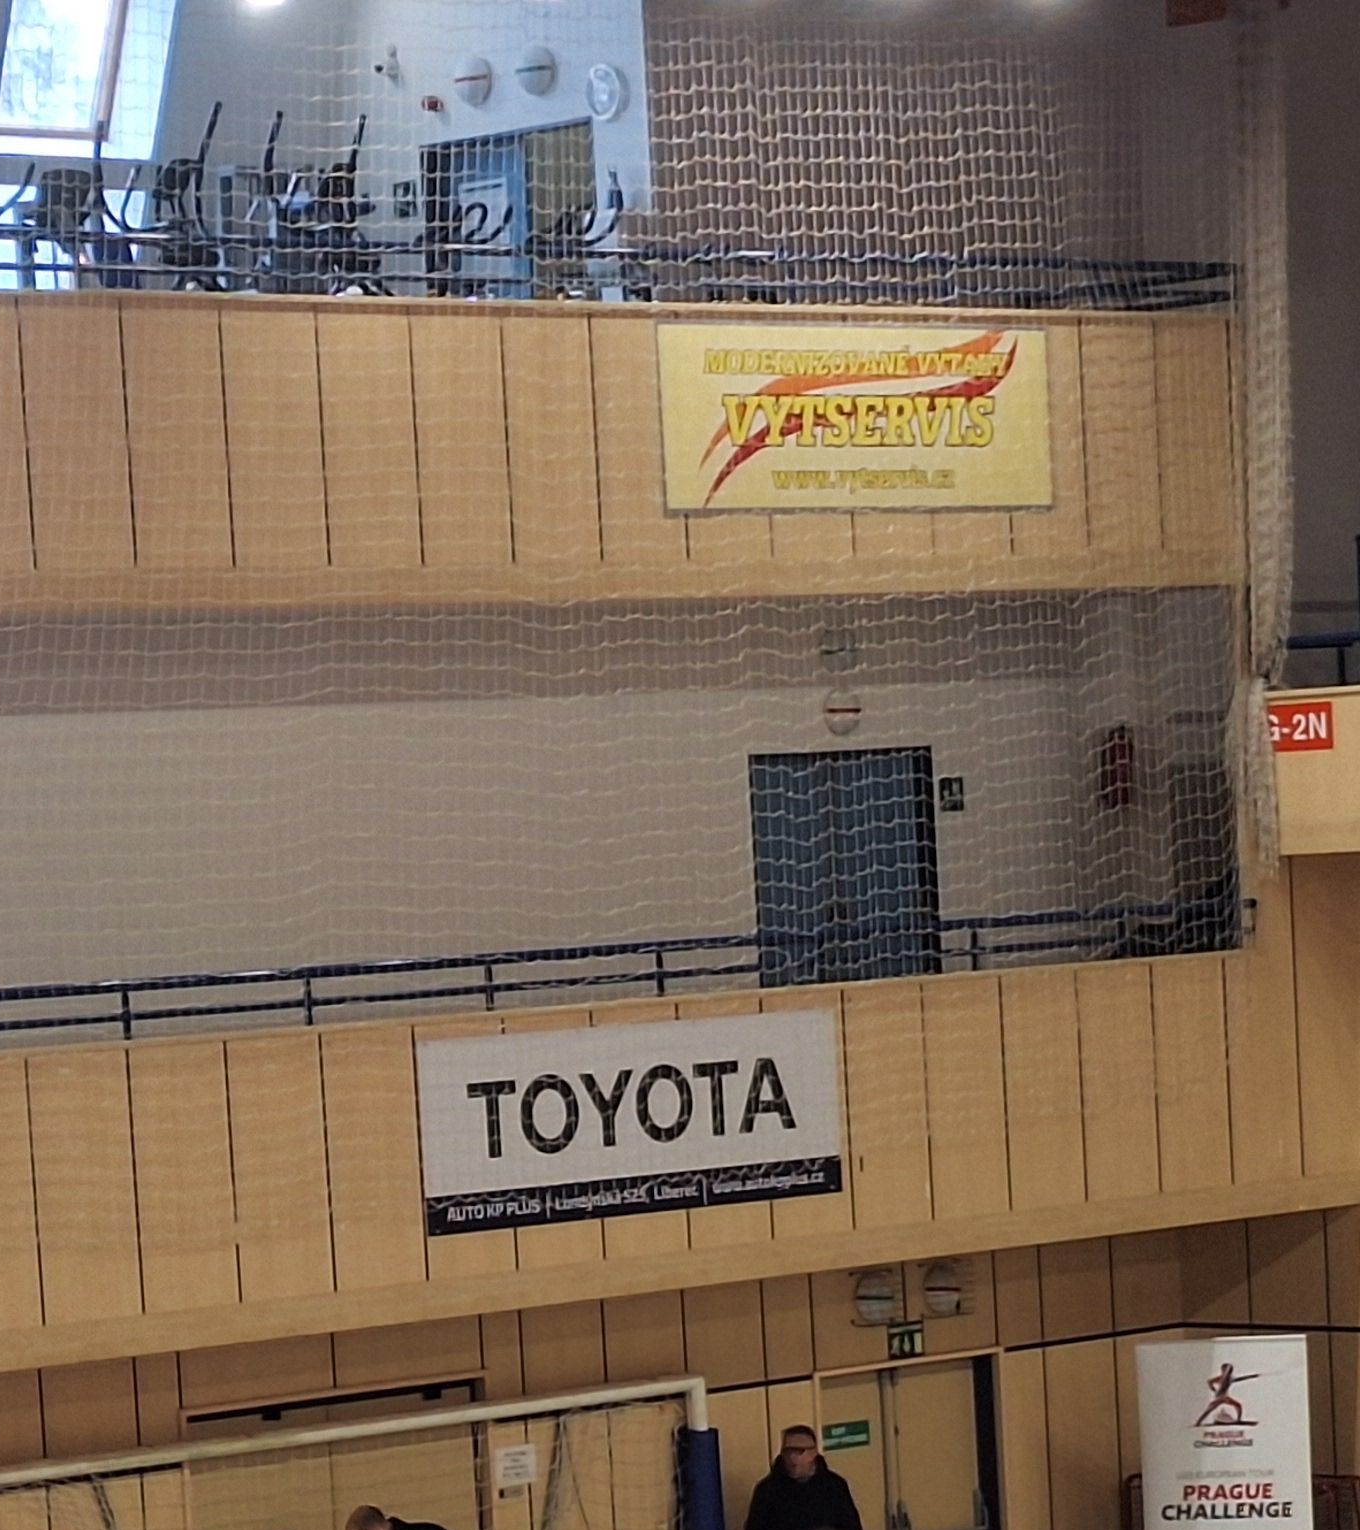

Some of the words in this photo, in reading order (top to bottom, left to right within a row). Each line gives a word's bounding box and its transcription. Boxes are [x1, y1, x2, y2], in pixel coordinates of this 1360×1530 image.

[722, 394, 995, 448] VYTSERVIS
[466, 1057, 797, 1159] TOYOTA
[446, 1201, 484, 1222] AUTO
[486, 1201, 505, 1219] KP
[506, 1196, 541, 1216] PLUS
[653, 1182, 700, 1201] Liberec
[1193, 1438, 1253, 1448] CHALLENGE
[1182, 1482, 1273, 1501] PRAGUE
[1161, 1501, 1293, 1521] CHALLENGE
